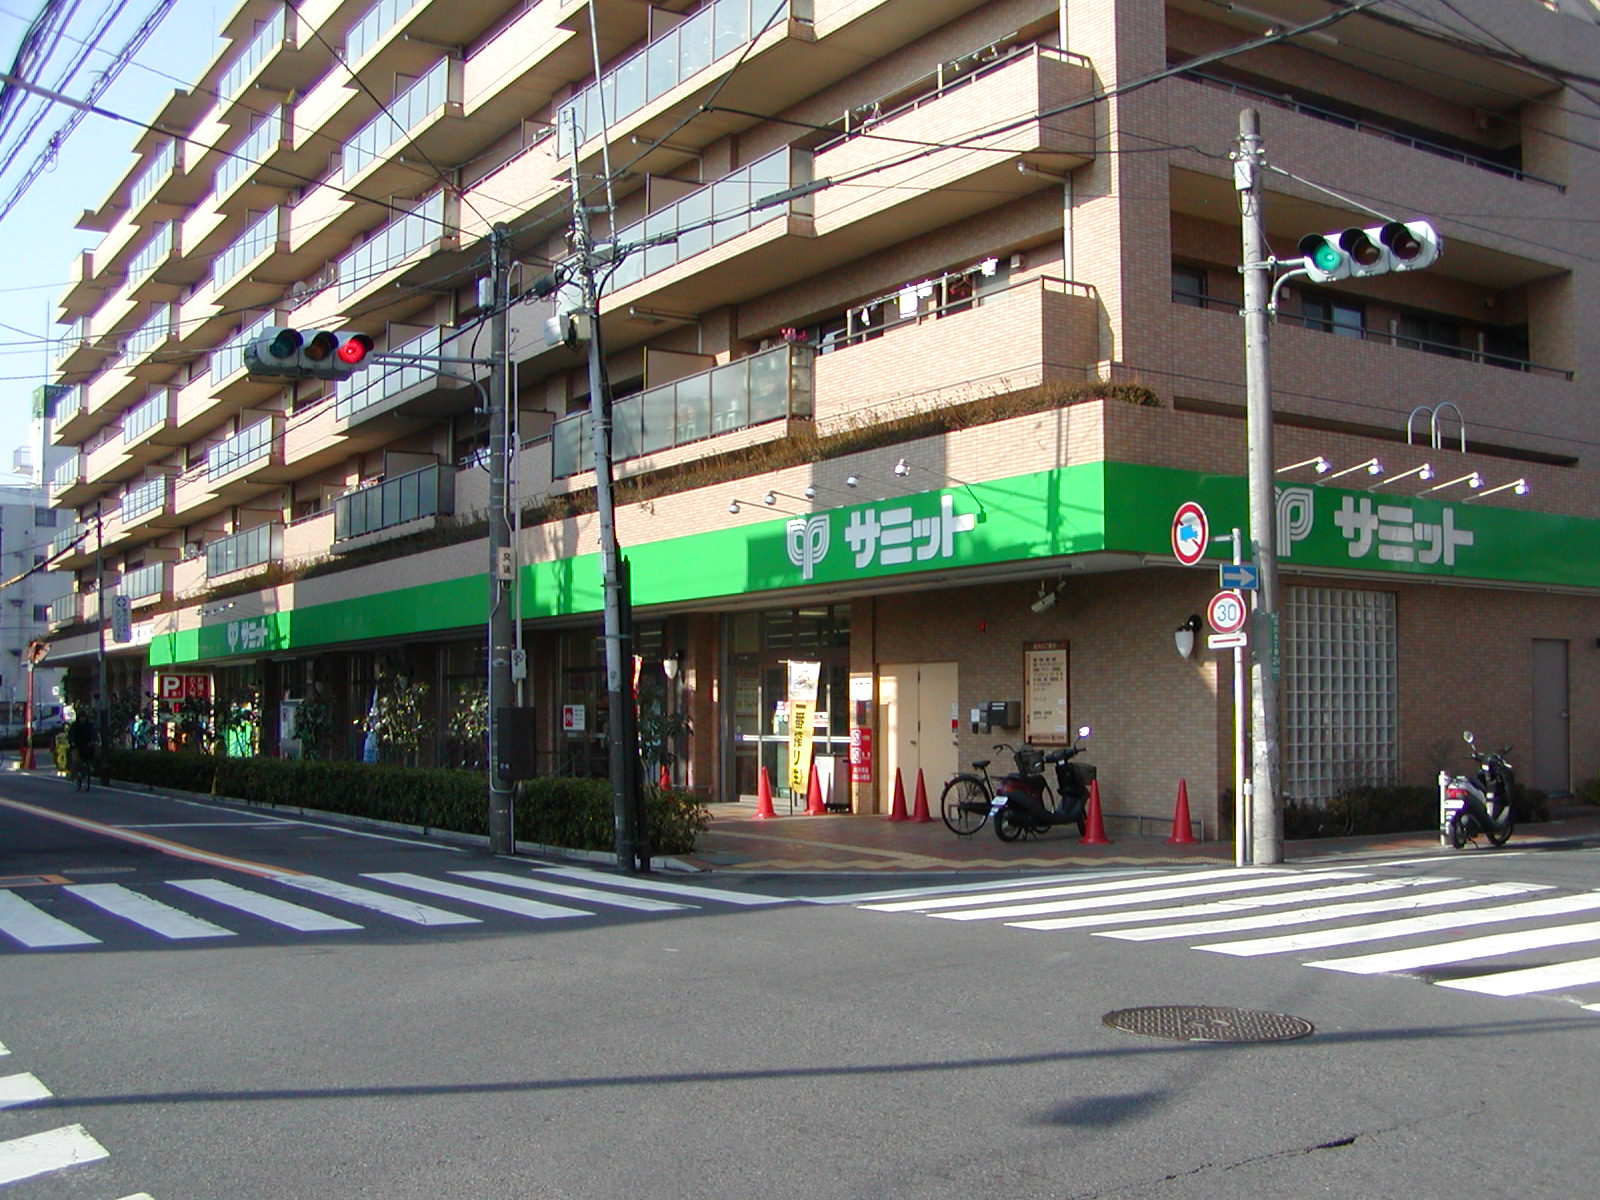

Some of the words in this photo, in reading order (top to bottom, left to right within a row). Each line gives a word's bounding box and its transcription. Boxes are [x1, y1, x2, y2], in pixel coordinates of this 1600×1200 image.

[844, 494, 976, 569] サミット
[1334, 495, 1475, 567] サミット
[1217, 603, 1237, 622] 30
[241, 618, 269, 650] サミット
[163, 677, 180, 698] P
